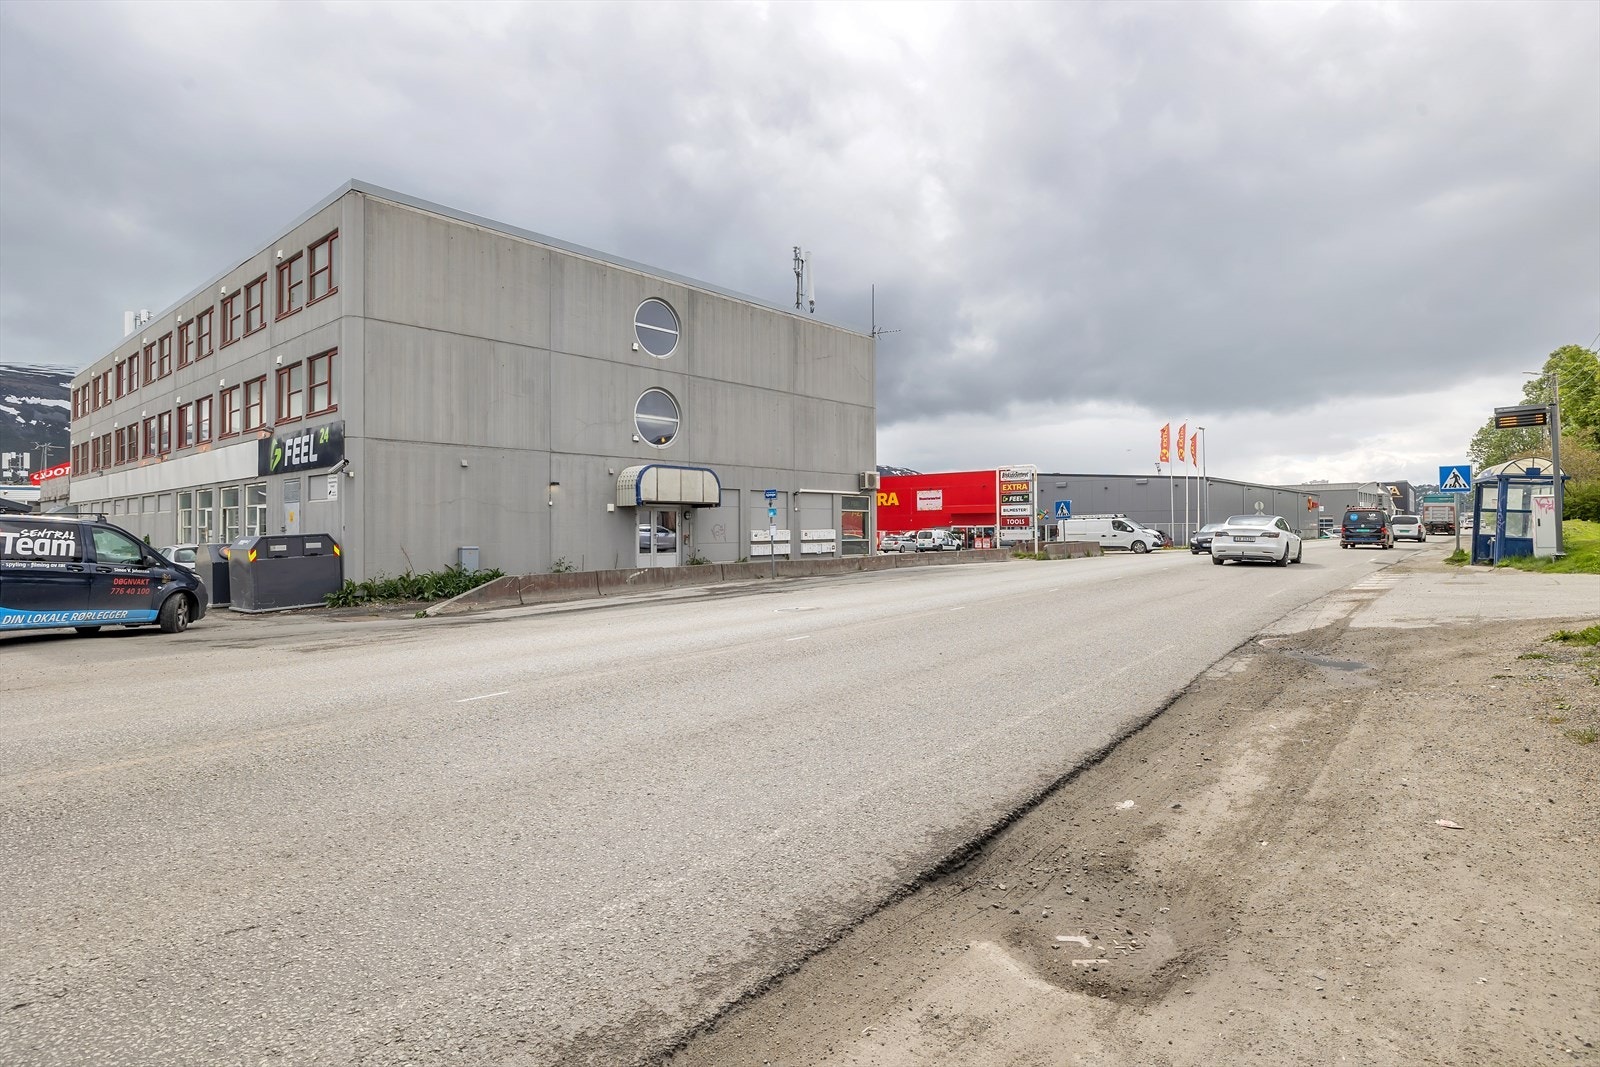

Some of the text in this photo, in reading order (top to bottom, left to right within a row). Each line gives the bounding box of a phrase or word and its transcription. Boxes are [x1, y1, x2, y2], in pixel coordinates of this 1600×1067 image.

[284, 427, 329, 466] FEEL 24
[20, 528, 75, 539] SENTRAL
[0, 532, 75, 557] Team
[2, 610, 128, 625] DIN LOKALE RØRLEGGER
